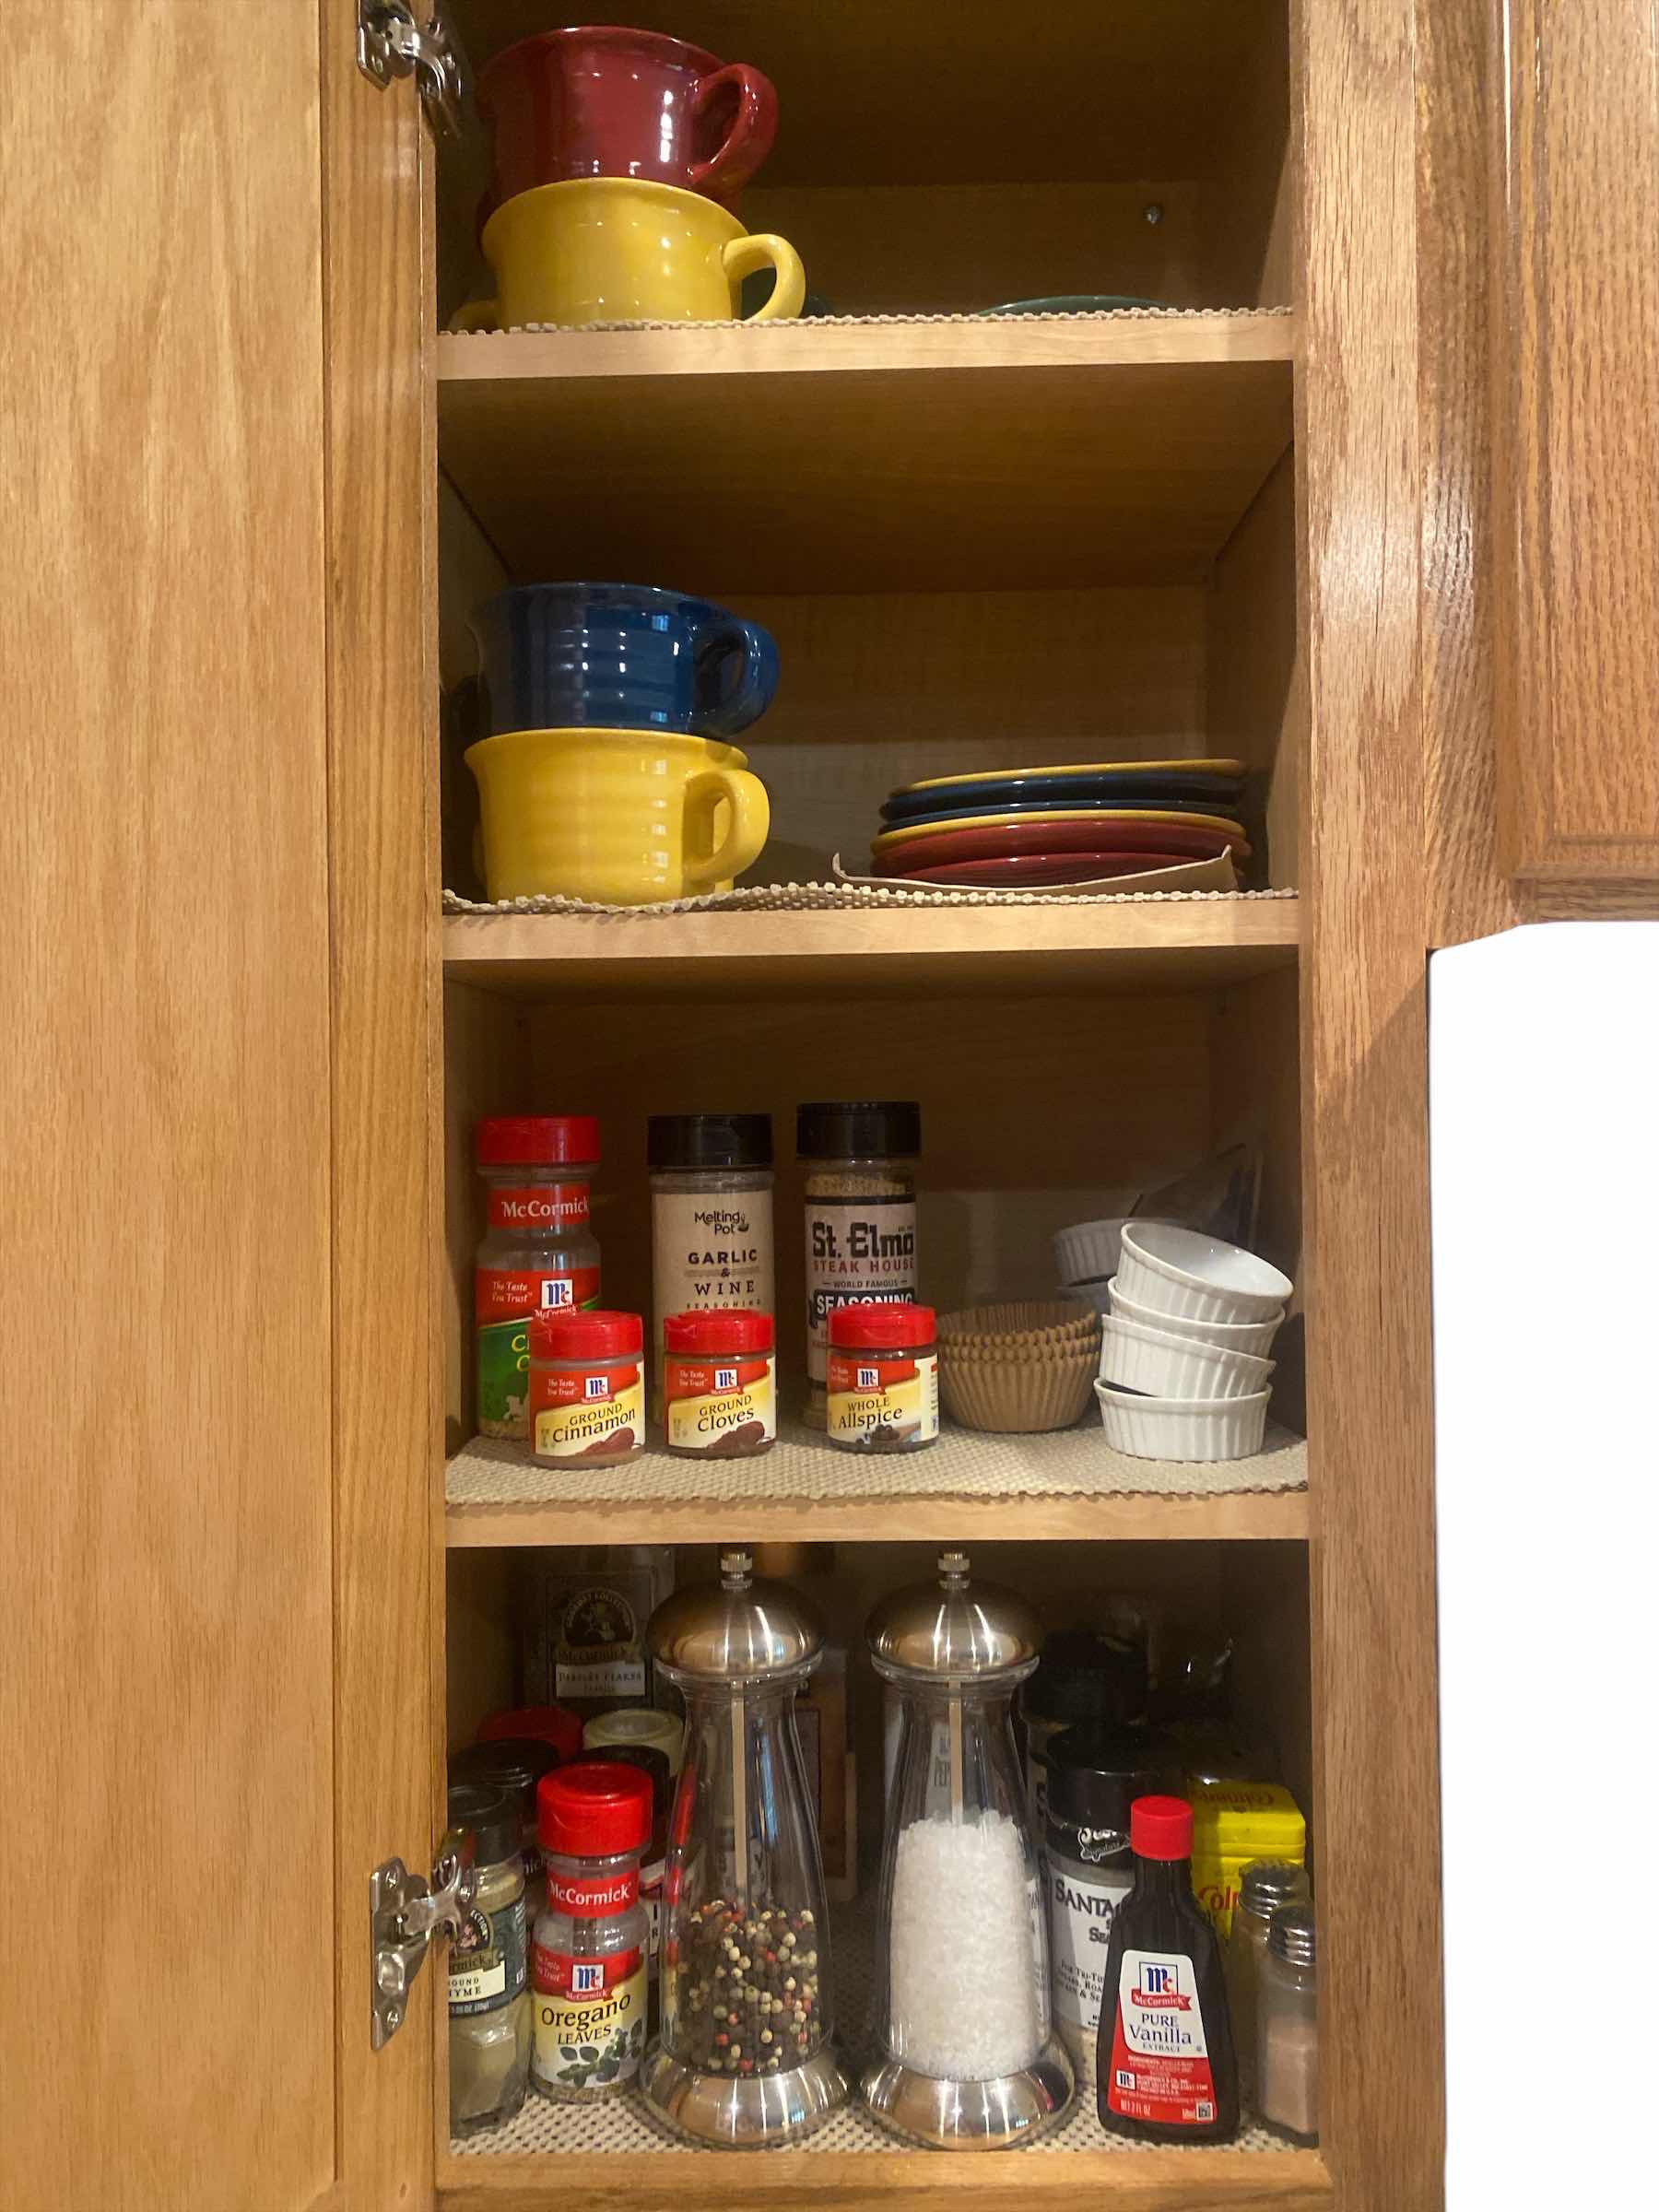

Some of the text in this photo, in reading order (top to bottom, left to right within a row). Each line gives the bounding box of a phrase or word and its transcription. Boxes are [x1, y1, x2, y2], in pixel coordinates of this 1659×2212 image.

[501, 1196, 589, 1218] McCormick
[694, 1209, 741, 1225] Melting
[714, 1224, 735, 1235] Pot
[812, 1221, 913, 1259] St. Elmo
[688, 1249, 758, 1265] GARLIC
[813, 1257, 913, 1274] STEAK HOUSE
[721, 1267, 730, 1277] &
[507, 1281, 528, 1291] Taste
[694, 1279, 755, 1296] WINE
[833, 1278, 899, 1288] WORLD FAMOUS
[534, 1304, 578, 1321] McCormick
[700, 1394, 752, 1417] GROUND
[848, 1396, 890, 1411] WHOLE
[570, 1403, 622, 1426] GROUND
[698, 1407, 754, 1432] Cloves
[839, 1407, 902, 1430] Allspice
[553, 1408, 635, 1442] Cinnamon
[549, 1880, 629, 1906] McCormick
[1055, 1877, 1113, 1918] SANTA
[451, 1977, 479, 1987] OUND
[449, 1985, 482, 1998] YME
[565, 1989, 608, 2001] McCormick
[1135, 1994, 1185, 2007] McCormick
[542, 1994, 631, 2031] Oregano
[1142, 2012, 1179, 2028] PURE
[558, 2024, 611, 2045] LEAVES
[1129, 2024, 1192, 2045] Vanilla
[1142, 2041, 1181, 2053] EXTRACT
